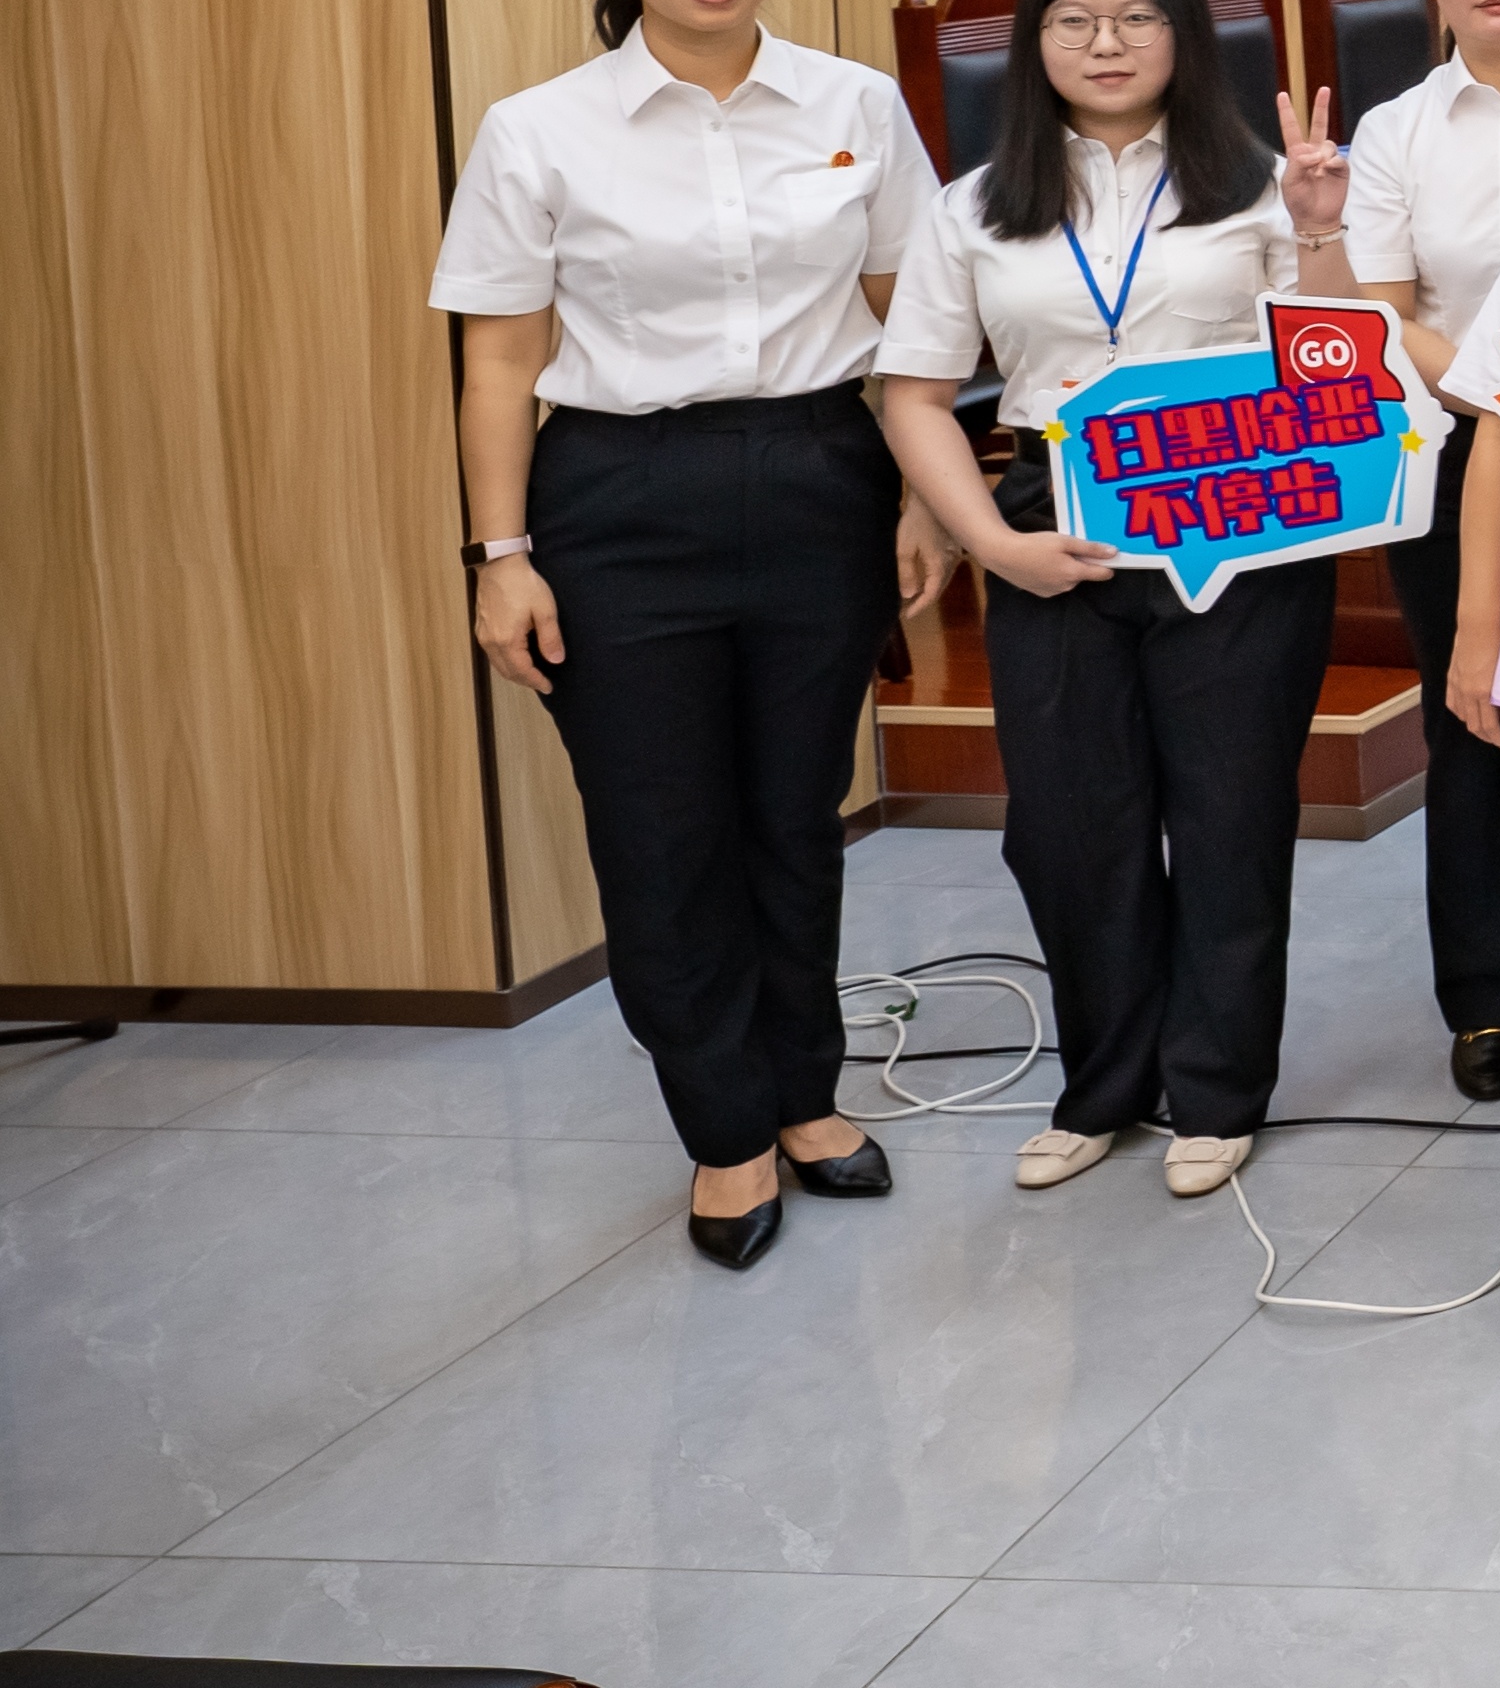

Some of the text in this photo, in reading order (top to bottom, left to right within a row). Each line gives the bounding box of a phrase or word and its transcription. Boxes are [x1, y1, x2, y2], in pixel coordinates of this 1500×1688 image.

[1298, 339, 1351, 368] GO
[1081, 375, 1386, 483] 扫黑除恶
[1117, 457, 1343, 549] 不停步
